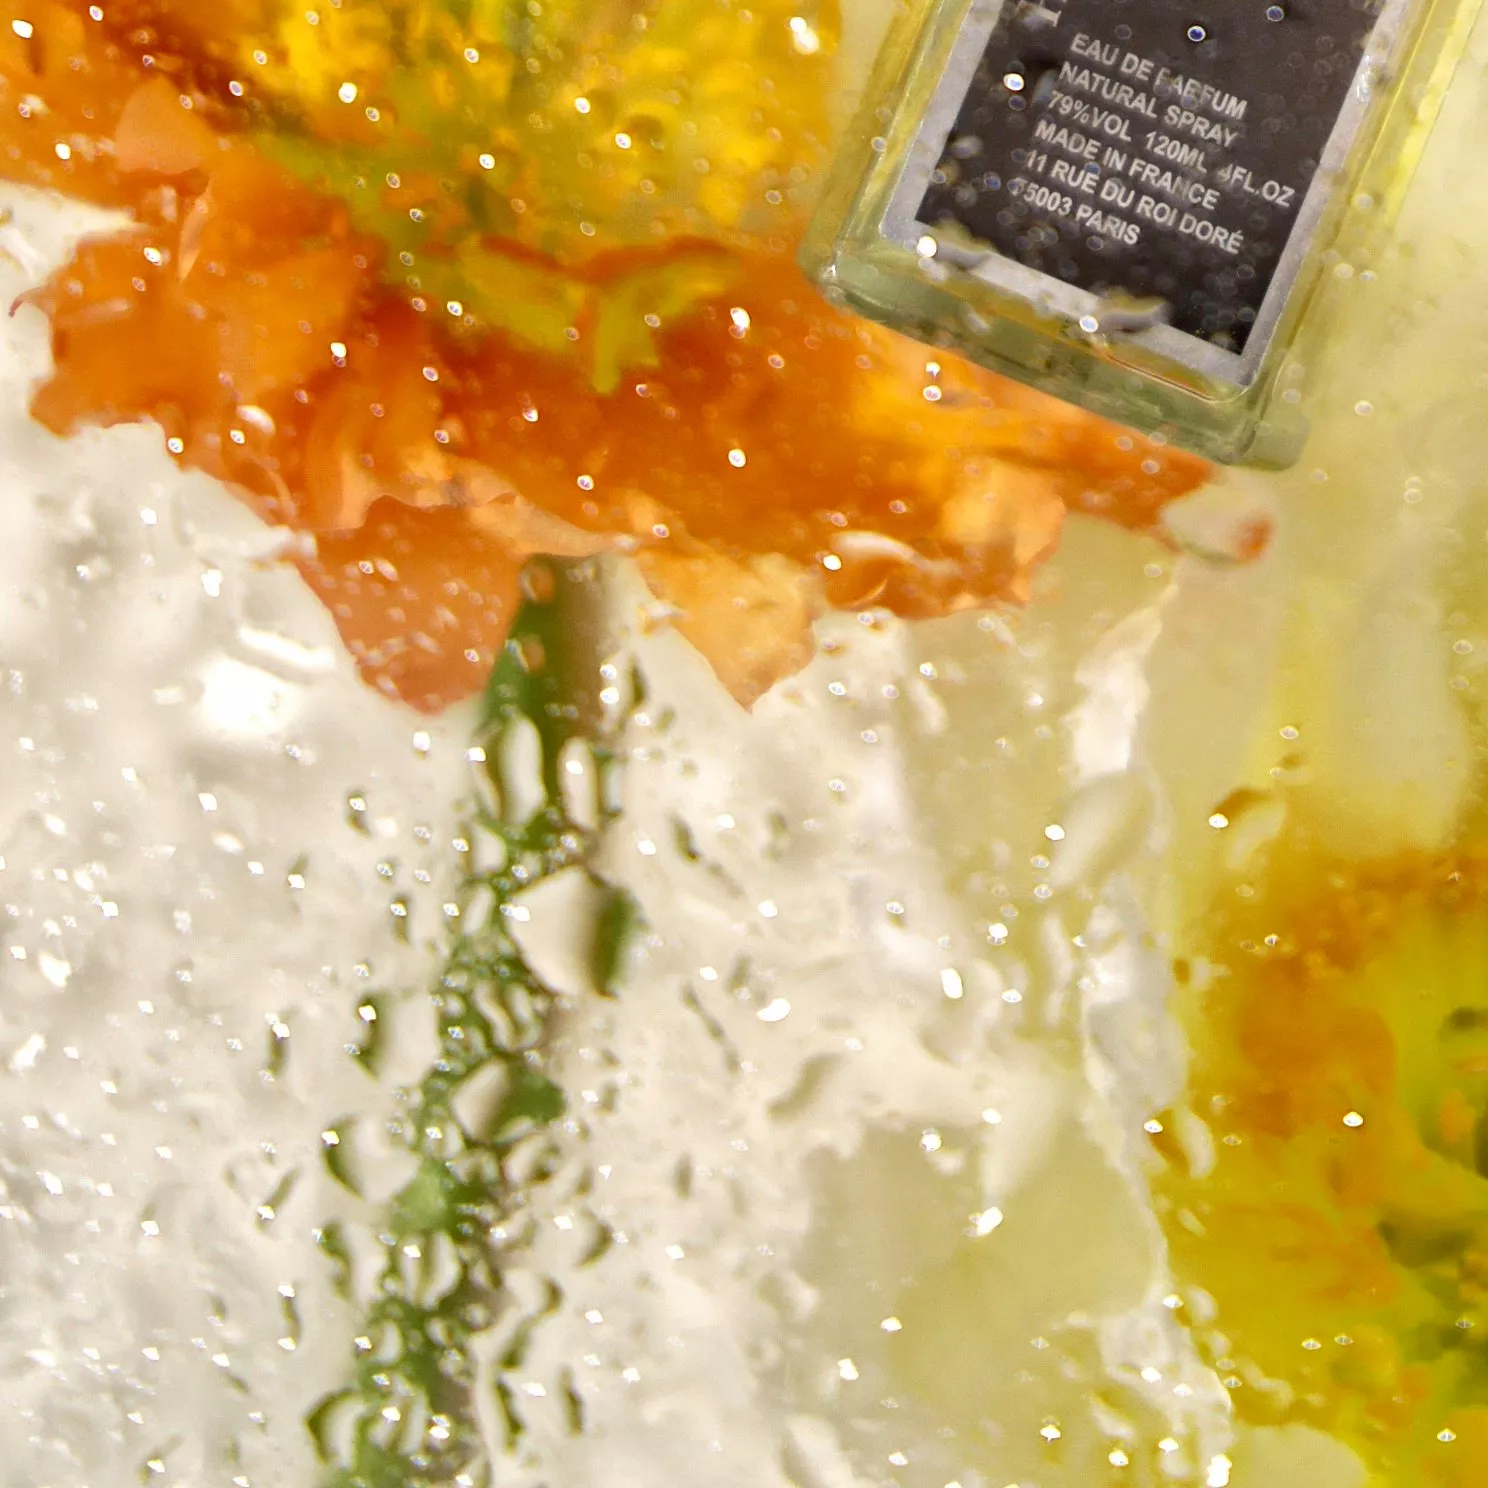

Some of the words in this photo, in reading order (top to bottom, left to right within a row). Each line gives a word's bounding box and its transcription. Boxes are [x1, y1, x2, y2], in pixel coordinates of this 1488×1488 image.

[1070, 32, 1119, 66] EAU
[1120, 52, 1155, 81] DE
[1059, 61, 1158, 118] NATURAL
[1164, 104, 1237, 148] SPRAY
[1034, 119, 1101, 161] MADE
[1103, 147, 1127, 172] IN
[1128, 158, 1220, 210] FRANCE
[1145, 130, 1208, 173] 120ML
[1027, 150, 1048, 172] 11
[1051, 159, 1100, 194] RUE
[1100, 179, 1136, 209] DU
[1136, 195, 1178, 227] ROI
[1179, 213, 1244, 255] DORÉ
[1075, 204, 1140, 245] PARIS
